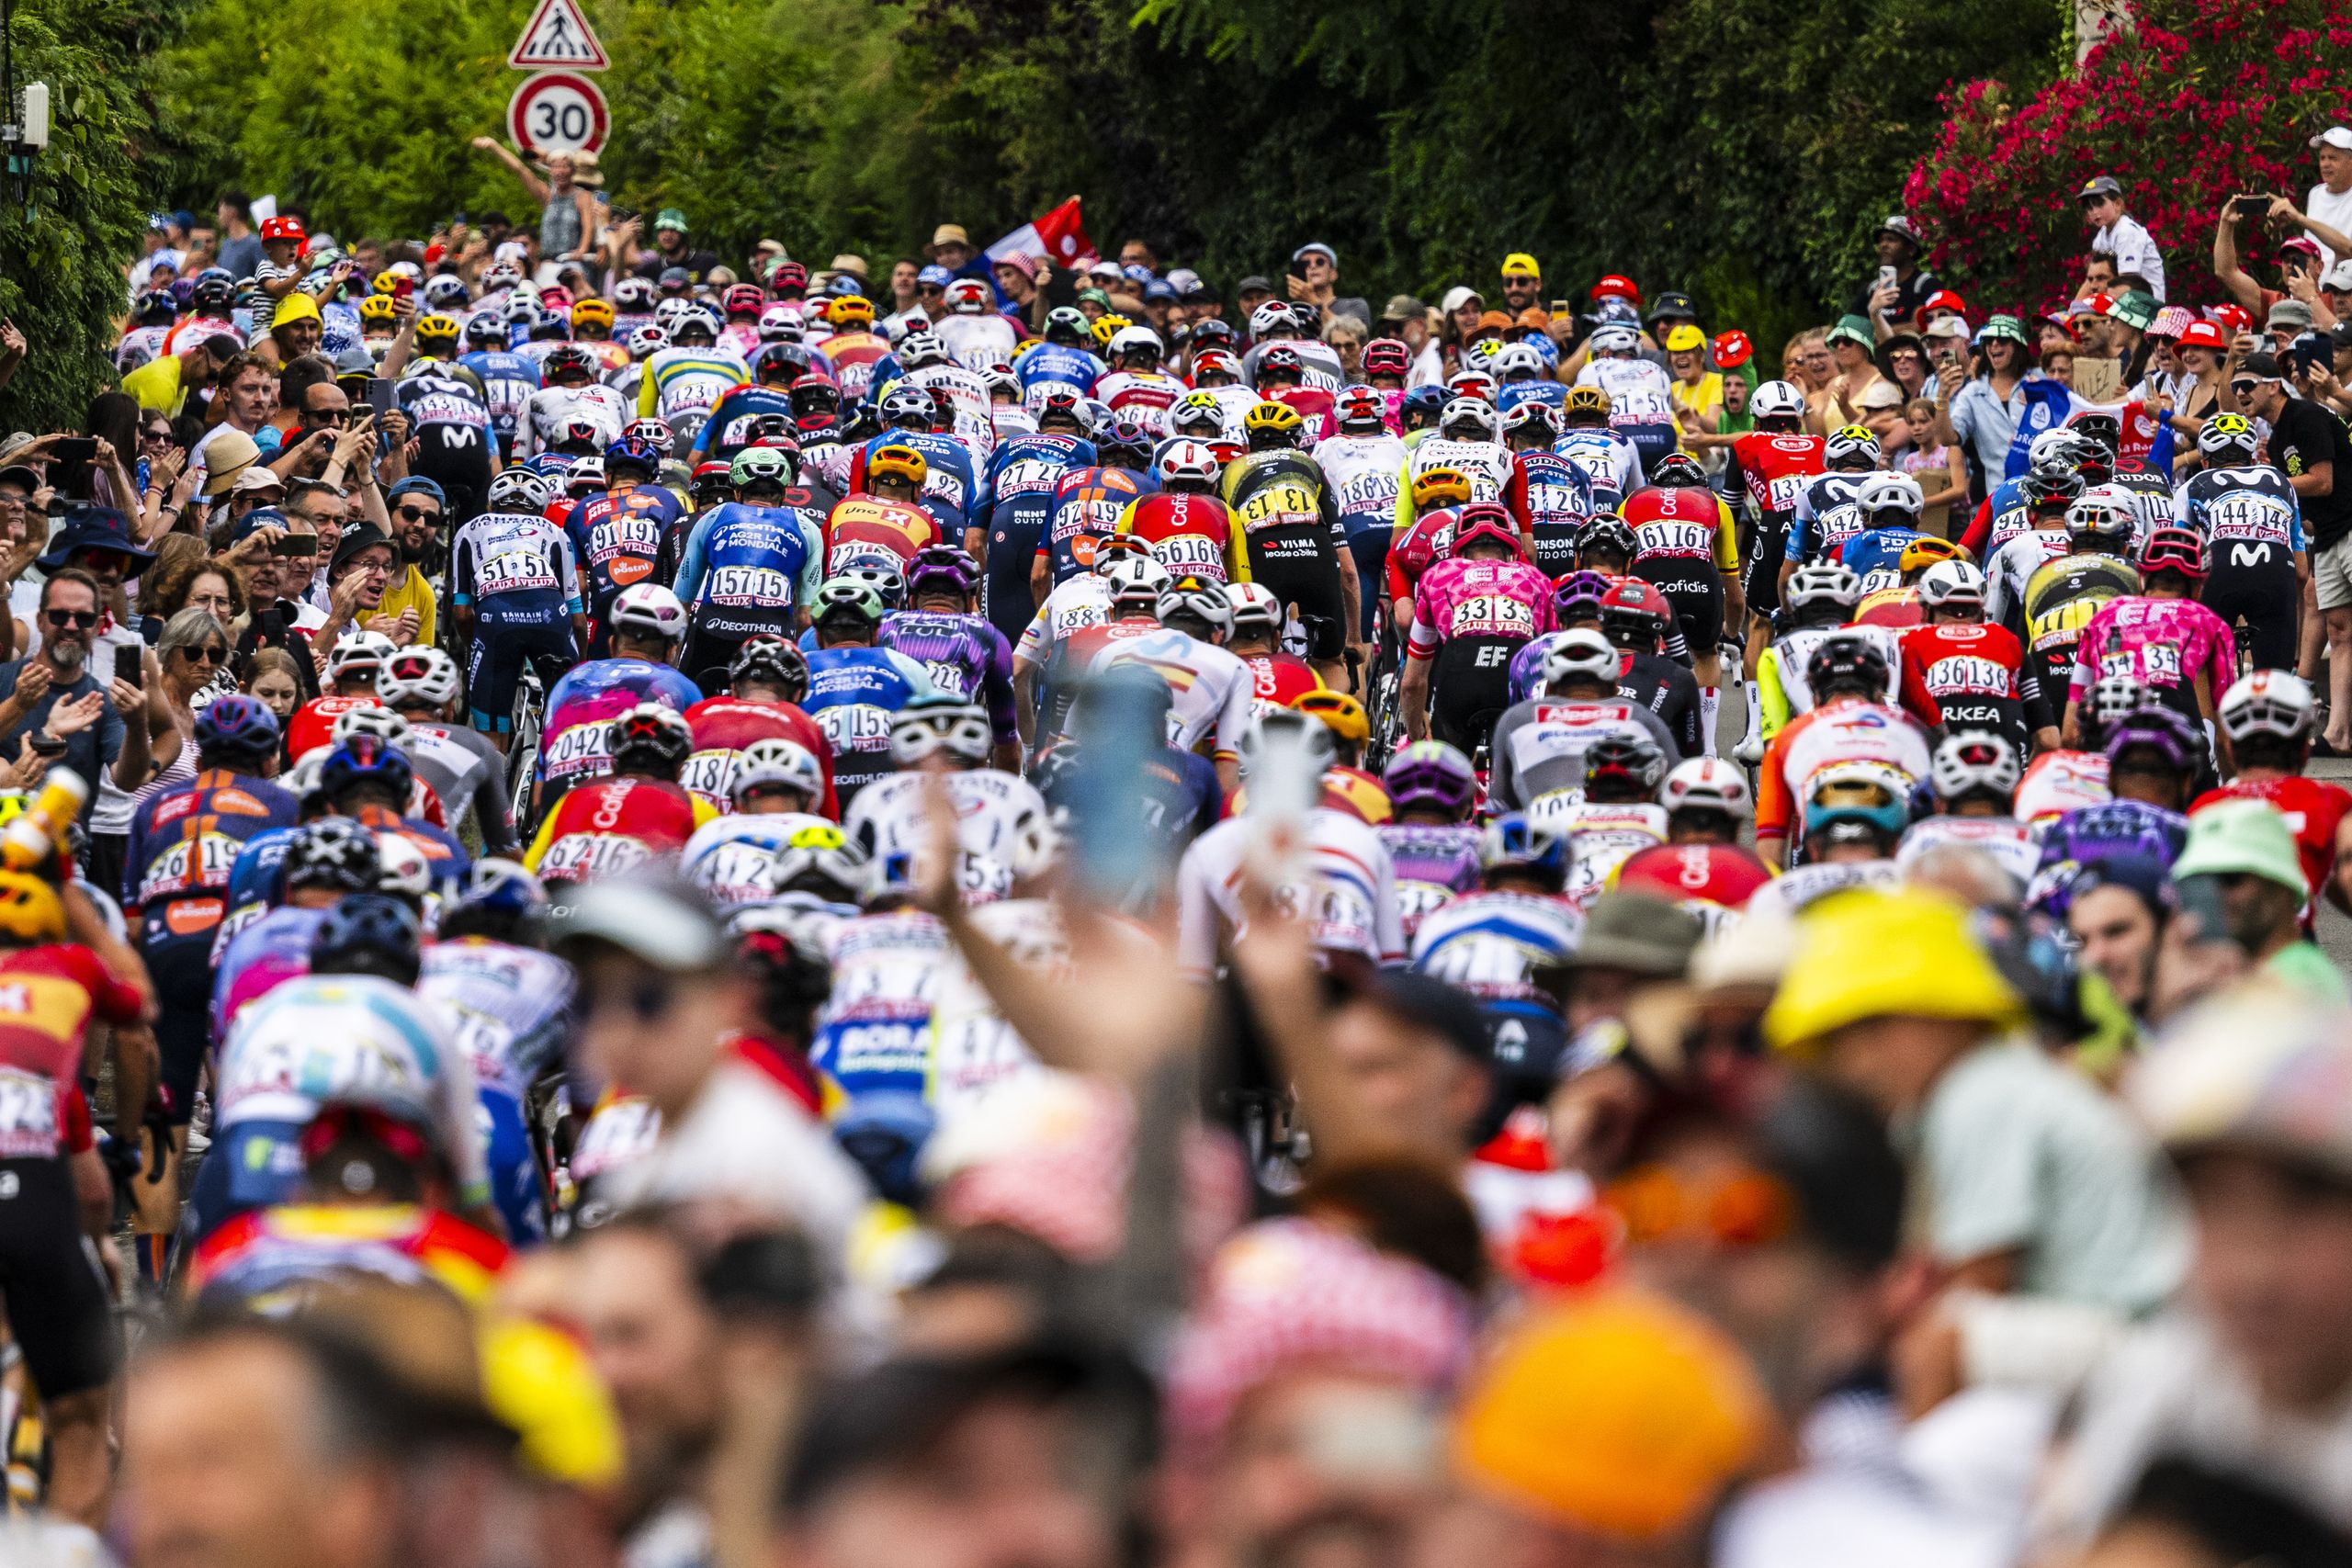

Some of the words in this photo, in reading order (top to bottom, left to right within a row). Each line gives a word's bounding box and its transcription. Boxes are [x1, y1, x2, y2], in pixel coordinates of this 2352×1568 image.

[535, 102, 586, 140] 30
[799, 428, 841, 442] UDO
[971, 420, 991, 441] 45
[905, 438, 936, 447] FDJ
[1002, 463, 1026, 489] 27
[1038, 462, 1063, 482] 27
[1589, 459, 1611, 478] 21
[939, 475, 959, 495] 92
[2111, 473, 2164, 485] TUDOR
[999, 482, 1030, 500] VELUX
[1343, 478, 1374, 504] 186
[1474, 483, 1498, 502] 43
[845, 506, 877, 515] Uno
[1247, 493, 1270, 520] 13
[1285, 489, 1311, 513] 13
[1344, 501, 1377, 515] VELUX
[1556, 491, 1583, 513] 26
[1774, 501, 1793, 512] VEL
[793, 506, 827, 522] DOR
[1014, 510, 1046, 518] RENS
[1093, 502, 1118, 522] 19
[1998, 512, 2026, 531] 94
[2215, 502, 2248, 528] 144
[1827, 511, 1860, 535] 142
[2213, 525, 2251, 539] VELUX
[626, 522, 658, 547] 191
[729, 523, 803, 549] DECATHLON
[729, 531, 762, 540] AG2R
[765, 532, 782, 545] LA
[1280, 538, 1316, 549] VISMA
[1536, 538, 1574, 549] ENSON
[1674, 525, 1707, 550] 161
[1992, 529, 2027, 542] VELU
[2039, 535, 2068, 543] UA
[624, 542, 658, 555] VELUX
[729, 538, 788, 558] MONDIALE
[1077, 546, 1096, 556] pos
[1157, 541, 1182, 566] 66
[1538, 551, 1575, 559] TDOOR
[482, 558, 508, 581] 51
[525, 555, 550, 578] 51
[613, 563, 650, 576] postnl
[1187, 566, 1227, 581] VELUX
[520, 578, 555, 587] VELUX
[713, 570, 751, 596] 157
[1654, 580, 1709, 593] Cofidis
[1868, 573, 1891, 593] 91
[1059, 608, 1094, 629] 188
[1458, 599, 1487, 623] 33
[1502, 599, 1532, 625] 33
[720, 620, 782, 634] DECATHLON
[1475, 646, 1508, 667] EF
[1929, 658, 1965, 689] 136
[1971, 660, 2007, 691] 136
[2049, 666, 2074, 676] leas
[1941, 705, 2001, 724] RKEA
[854, 739, 892, 752] VELU
[832, 772, 893, 785] ECATHLON
